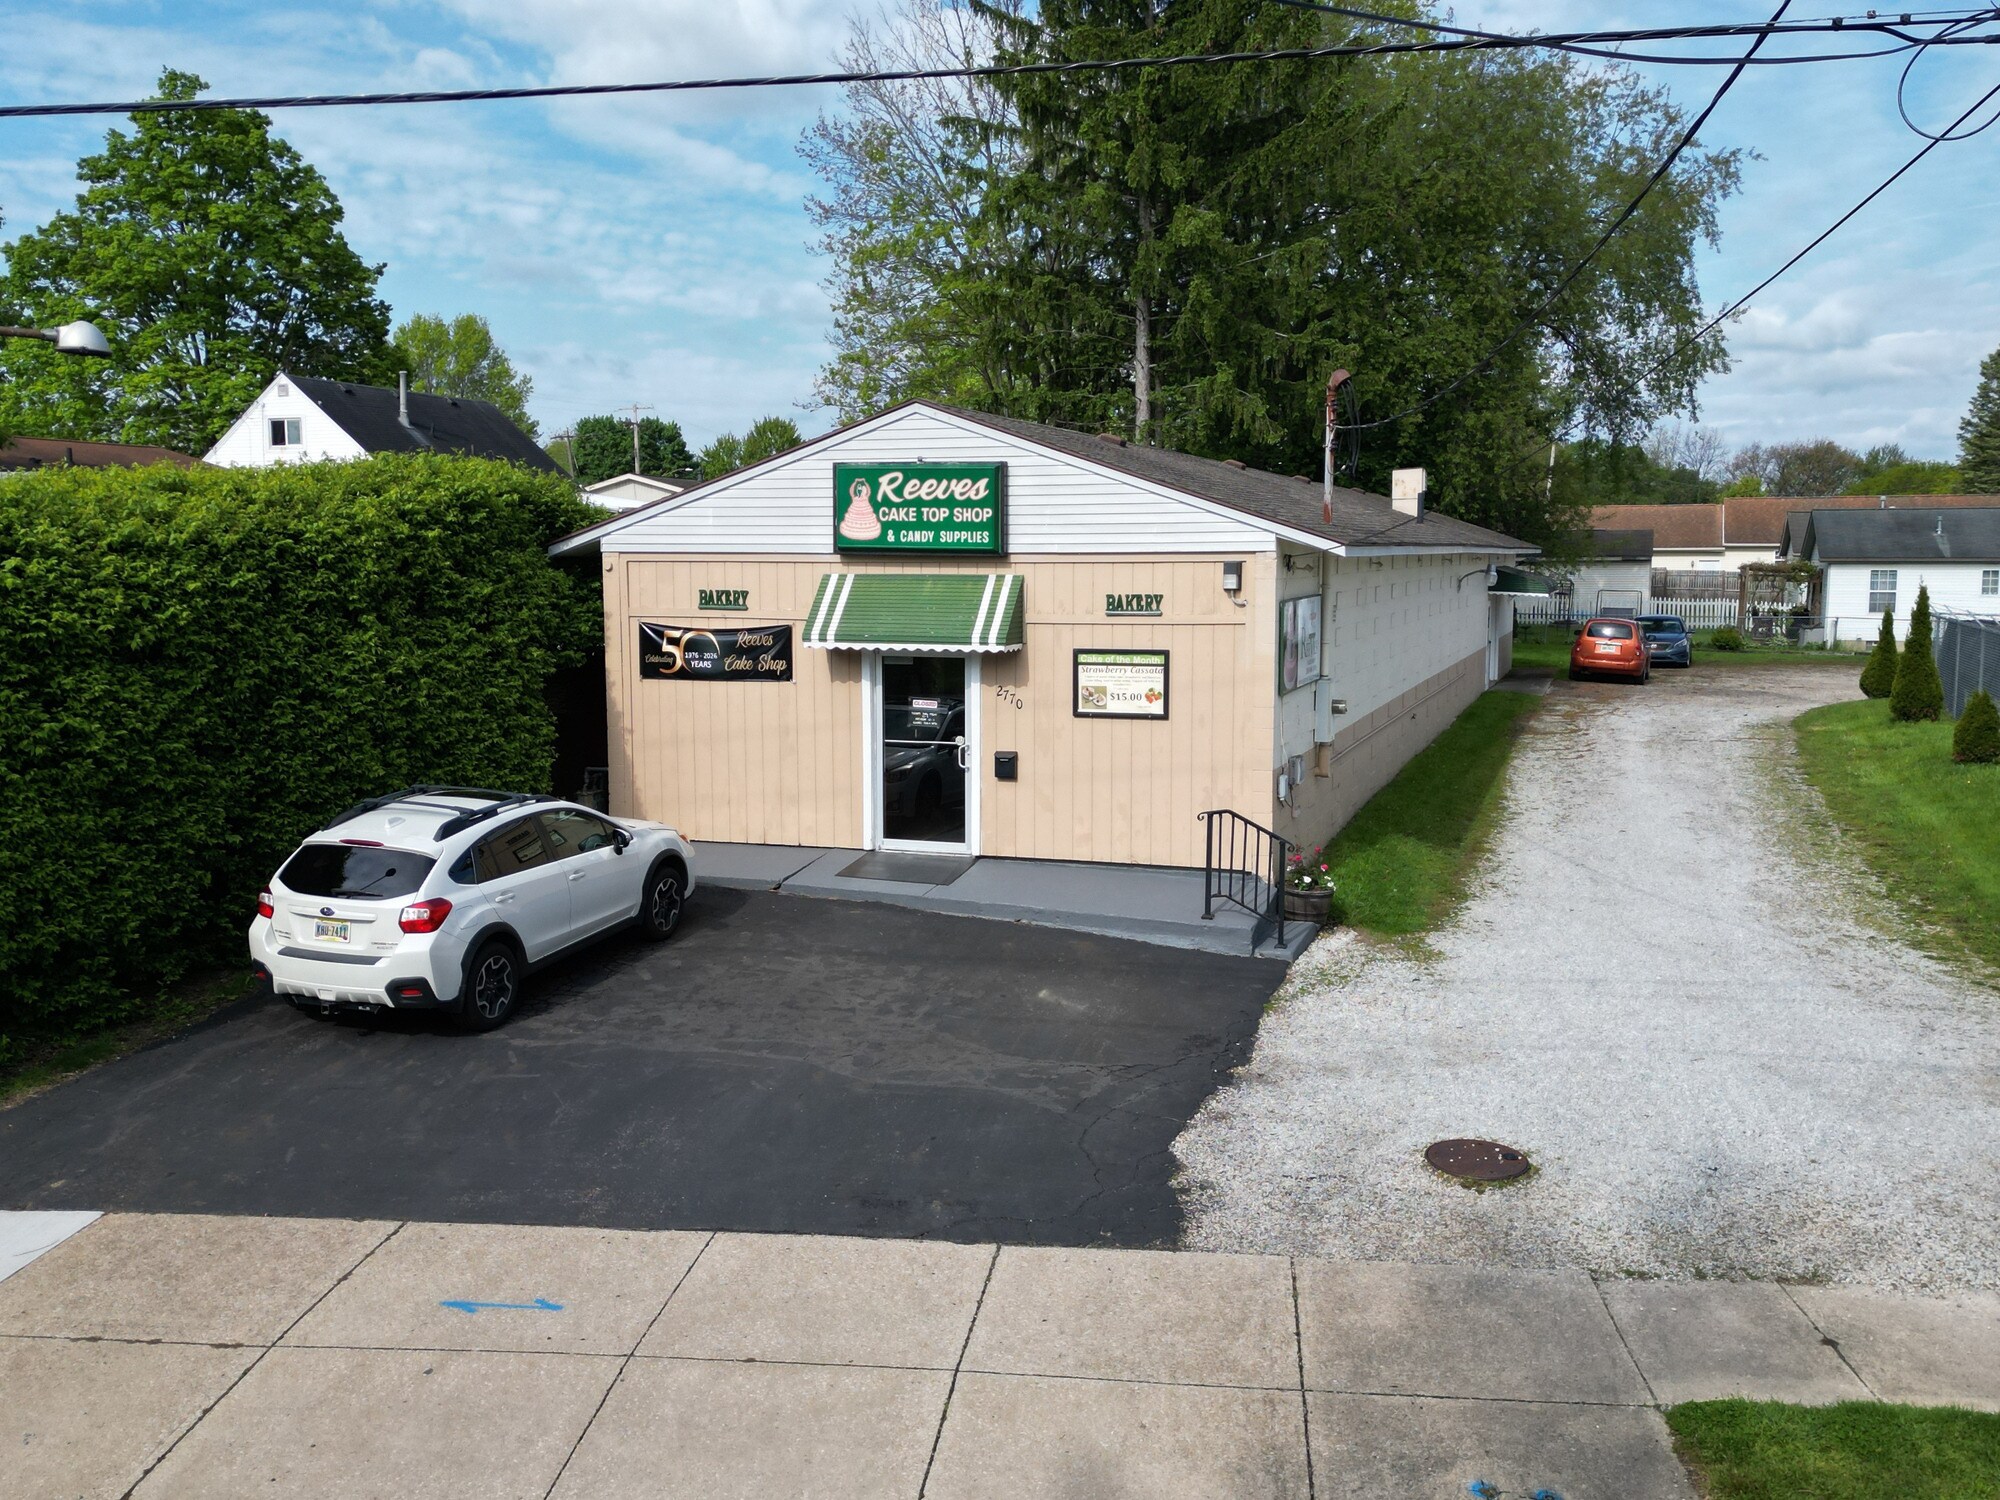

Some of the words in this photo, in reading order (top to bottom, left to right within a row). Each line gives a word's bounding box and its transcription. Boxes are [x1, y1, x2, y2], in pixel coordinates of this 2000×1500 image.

[877, 471, 989, 503] Reeves
[879, 507, 917, 522] CAKE
[921, 508, 950, 522] TOP
[953, 507, 993, 523] SHOP
[887, 530, 895, 542] &
[900, 530, 934, 543] CANDY
[940, 531, 989, 543] SUPPLIES
[699, 590, 749, 607] BAKERY
[1106, 594, 1163, 612] BAKERY
[736, 631, 773, 648] Reeves
[645, 653, 674, 665] Celebrating
[724, 654, 753, 671] Cake
[758, 654, 787, 675] Shop
[1080, 654, 1103, 663] Cake
[1105, 655, 1114, 663] of
[1116, 655, 1131, 664] the
[1133, 655, 1161, 664] Month
[1081, 666, 1128, 675] Strawberry
[1130, 666, 1164, 675] Cassata
[997, 686, 1023, 709] 2770
[1110, 692, 1142, 702] $15.00
